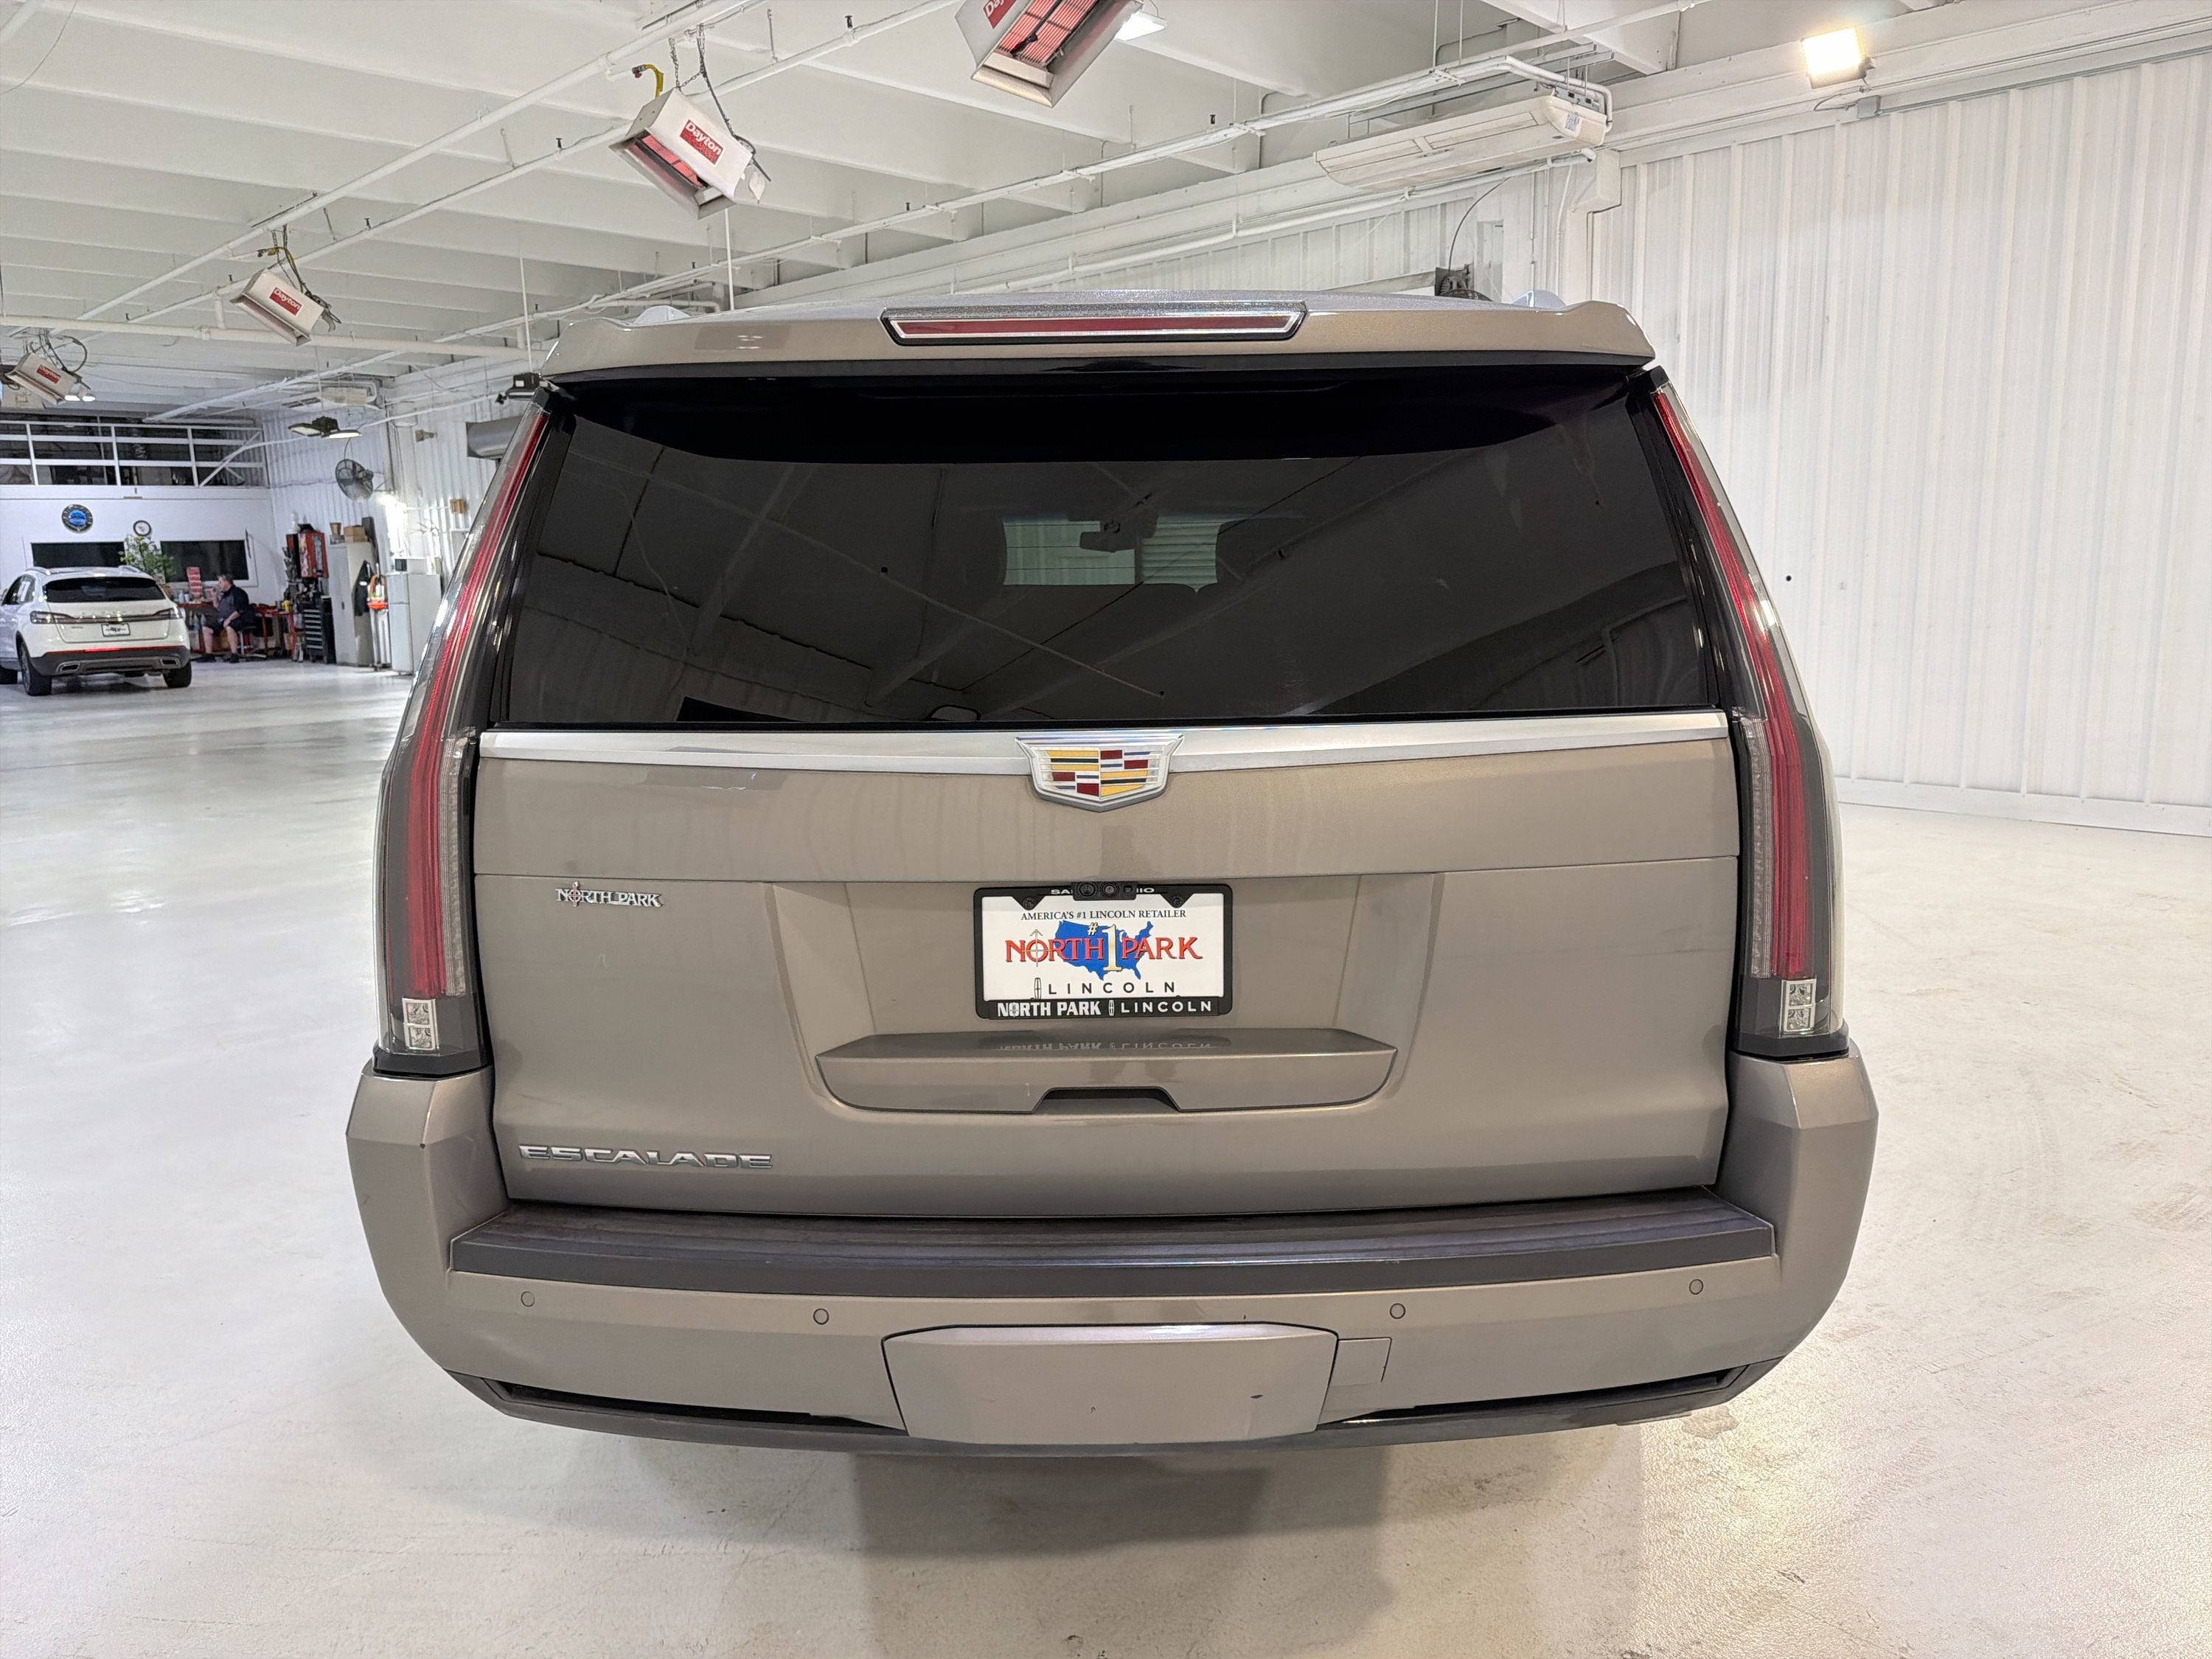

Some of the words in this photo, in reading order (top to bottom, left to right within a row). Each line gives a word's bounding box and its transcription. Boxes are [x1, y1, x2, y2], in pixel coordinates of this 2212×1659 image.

[685, 121, 722, 156] Dayton
[274, 288, 301, 310] Dayton
[555, 888, 613, 904] NORTH
[614, 891, 662, 908] PARK
[1020, 911, 1074, 920] AMERICA'S
[1077, 911, 1086, 919] #1
[1089, 910, 1135, 919] LINCOLN
[1138, 909, 1187, 919] RETAILER
[1005, 937, 1105, 962] NORTH
[1121, 936, 1203, 960] PARK
[1048, 981, 1175, 995] LINCOLN
[998, 1001, 1051, 1017] NORTH
[1057, 1001, 1102, 1016] PARK
[1121, 1000, 1212, 1014] LINCOLN
[518, 1144, 773, 1169] ESCALADE
